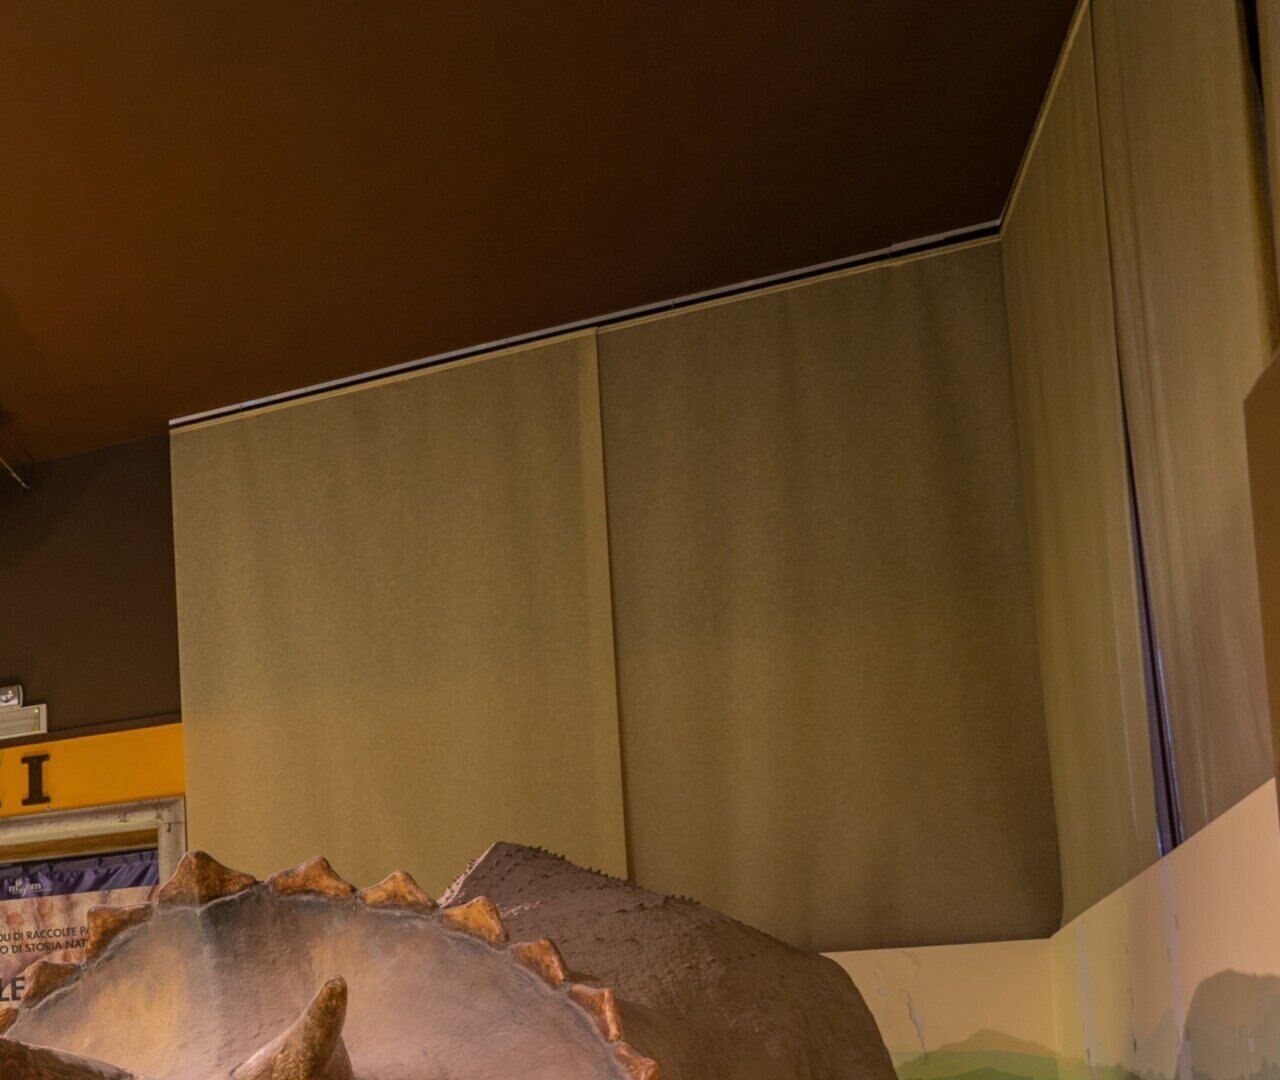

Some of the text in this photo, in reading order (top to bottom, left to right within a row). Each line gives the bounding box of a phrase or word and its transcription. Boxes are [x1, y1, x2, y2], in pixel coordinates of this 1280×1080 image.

[14, 931, 24, 941] DI
[27, 926, 77, 940] RACCOLTE
[11, 944, 22, 954] DI
[25, 940, 62, 952] STORIA
